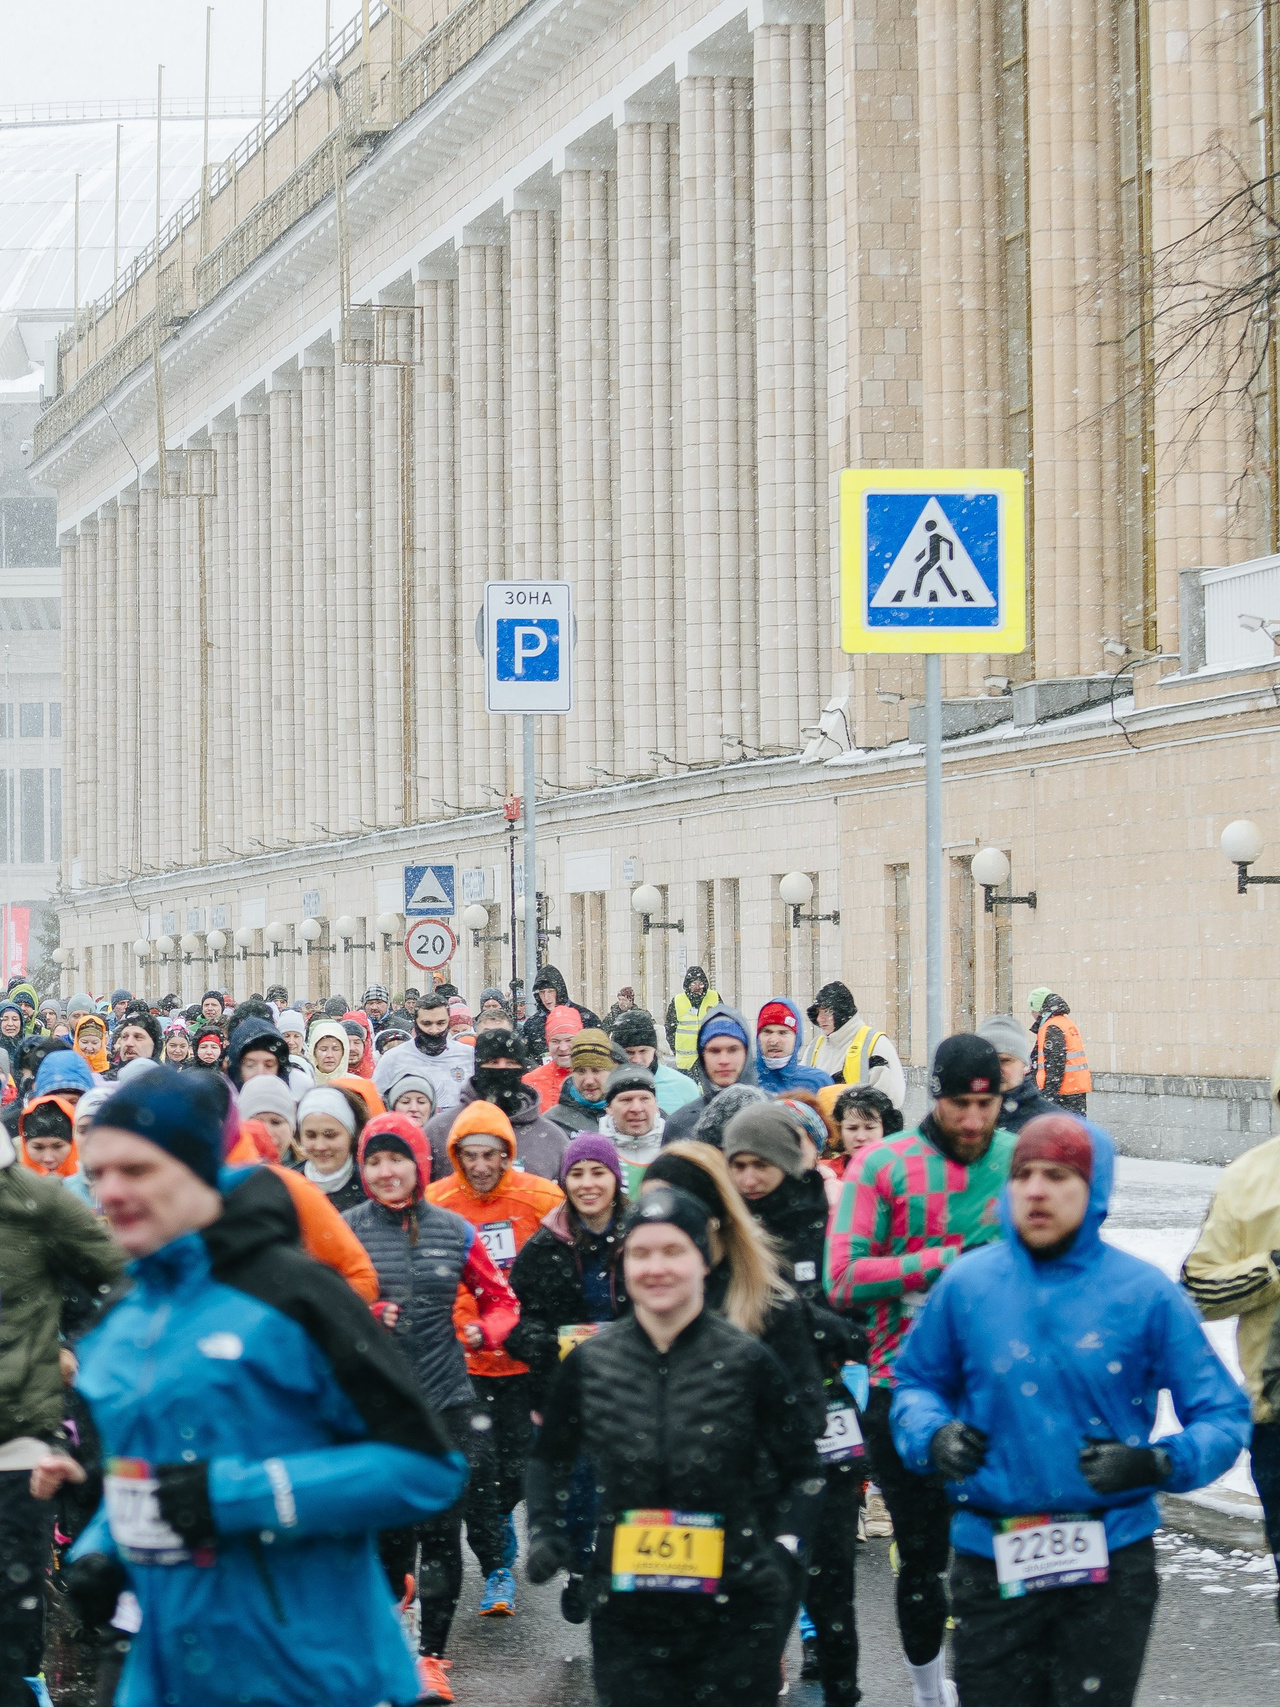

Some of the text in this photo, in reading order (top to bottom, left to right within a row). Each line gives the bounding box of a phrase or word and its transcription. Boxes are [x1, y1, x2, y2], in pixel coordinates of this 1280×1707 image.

[505, 592, 552, 605] ЗОНА
[514, 626, 548, 674] P
[417, 935, 445, 955] 20
[636, 1531, 693, 1559] 461
[1009, 1528, 1088, 1564] 2286
